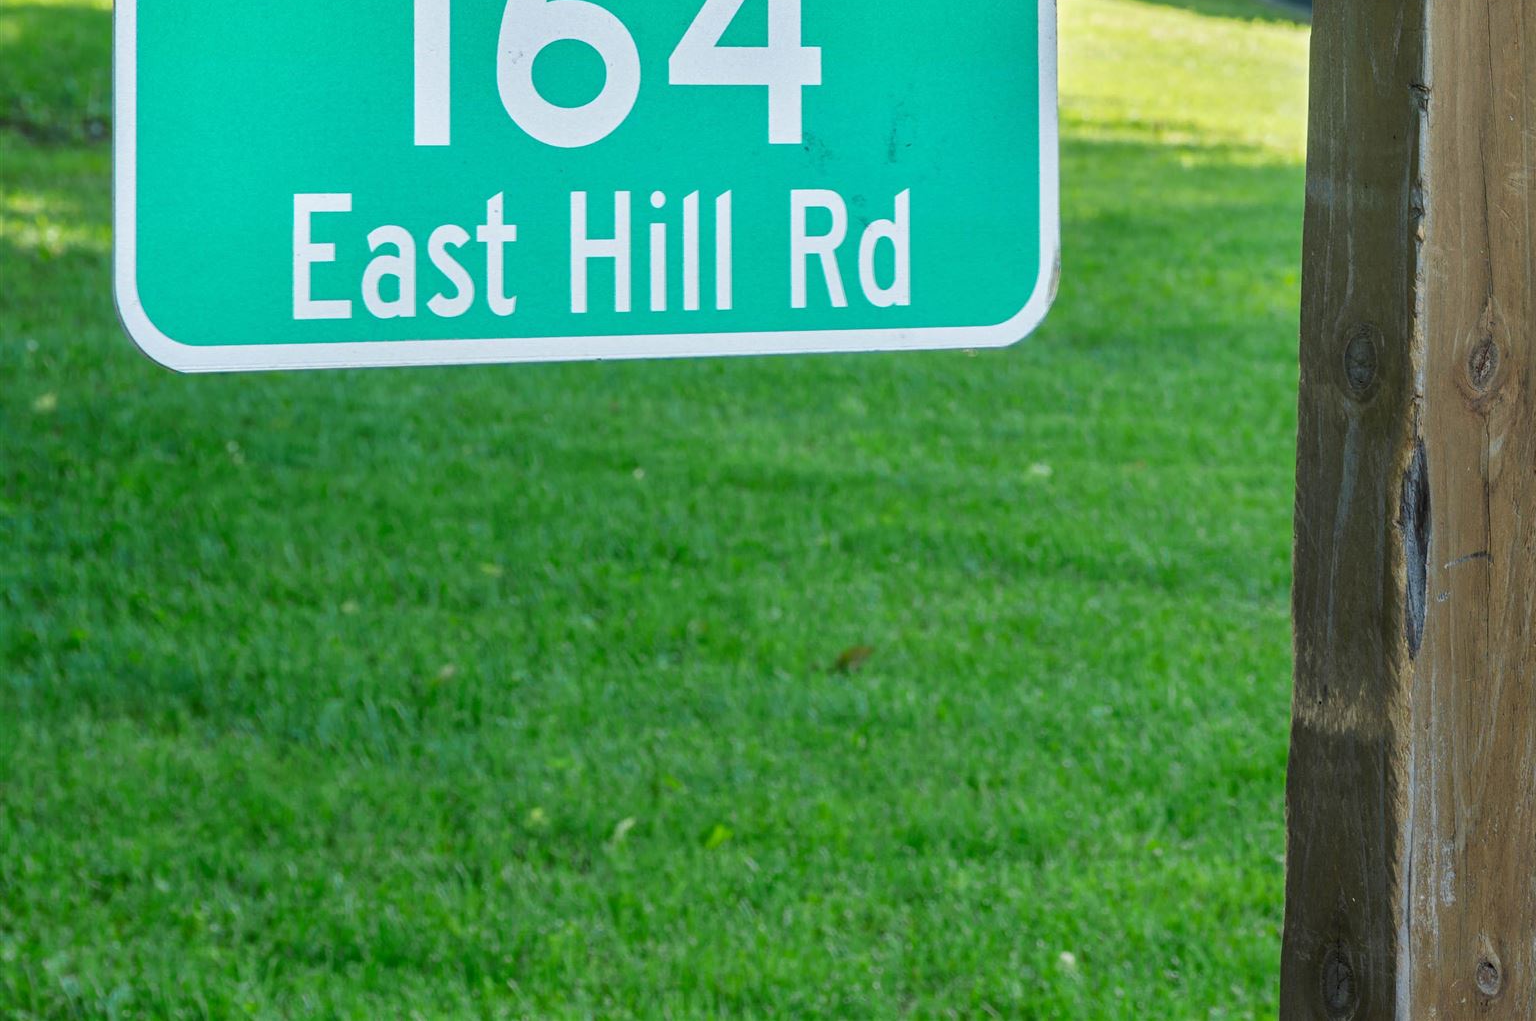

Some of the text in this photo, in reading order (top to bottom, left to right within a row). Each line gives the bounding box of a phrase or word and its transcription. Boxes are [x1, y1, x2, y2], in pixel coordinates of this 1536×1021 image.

[293, 188, 911, 320] East Hill Rd
